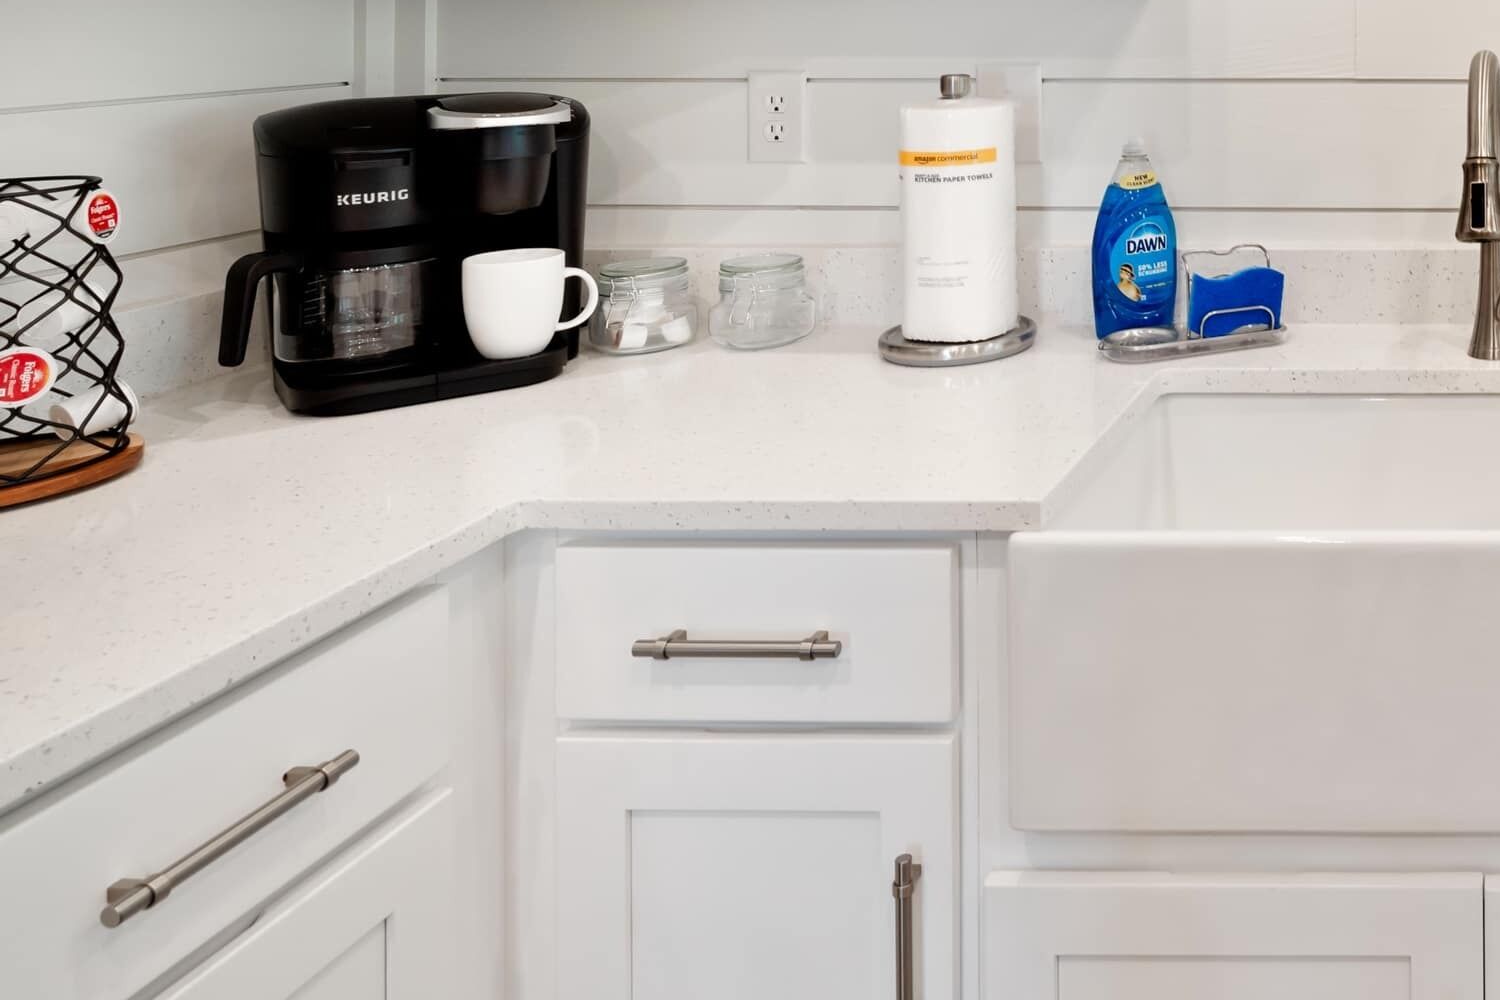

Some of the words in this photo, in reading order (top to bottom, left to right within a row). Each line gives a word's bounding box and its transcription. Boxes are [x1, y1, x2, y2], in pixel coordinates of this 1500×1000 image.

[942, 175, 966, 183] PAPER
[967, 172, 993, 182] TOWELS
[337, 189, 409, 206] KEURIG
[90, 204, 112, 215] Folgers
[1127, 235, 1167, 254] DAWN
[19, 361, 36, 393] Folgers
